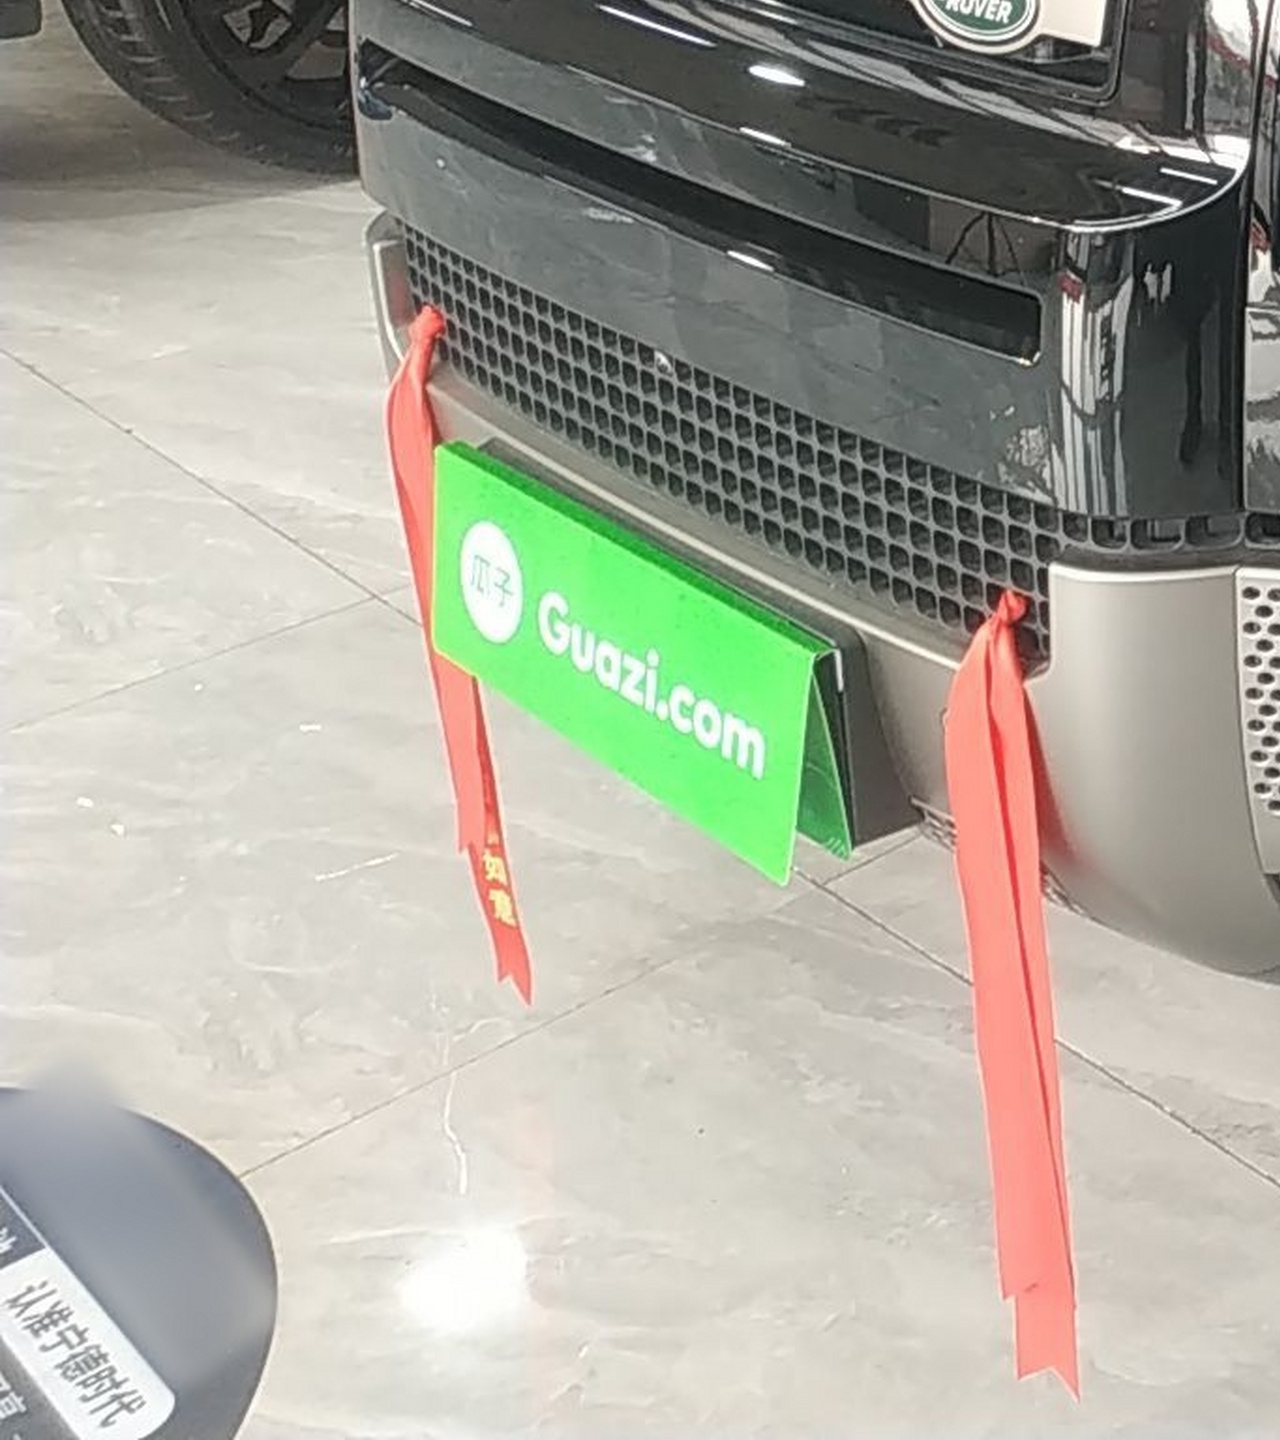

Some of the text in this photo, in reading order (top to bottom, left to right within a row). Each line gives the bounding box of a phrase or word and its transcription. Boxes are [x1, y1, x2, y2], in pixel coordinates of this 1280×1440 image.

[538, 591, 766, 780] Guazi.com
[5, 1280, 146, 1428] 认准宁德时代
